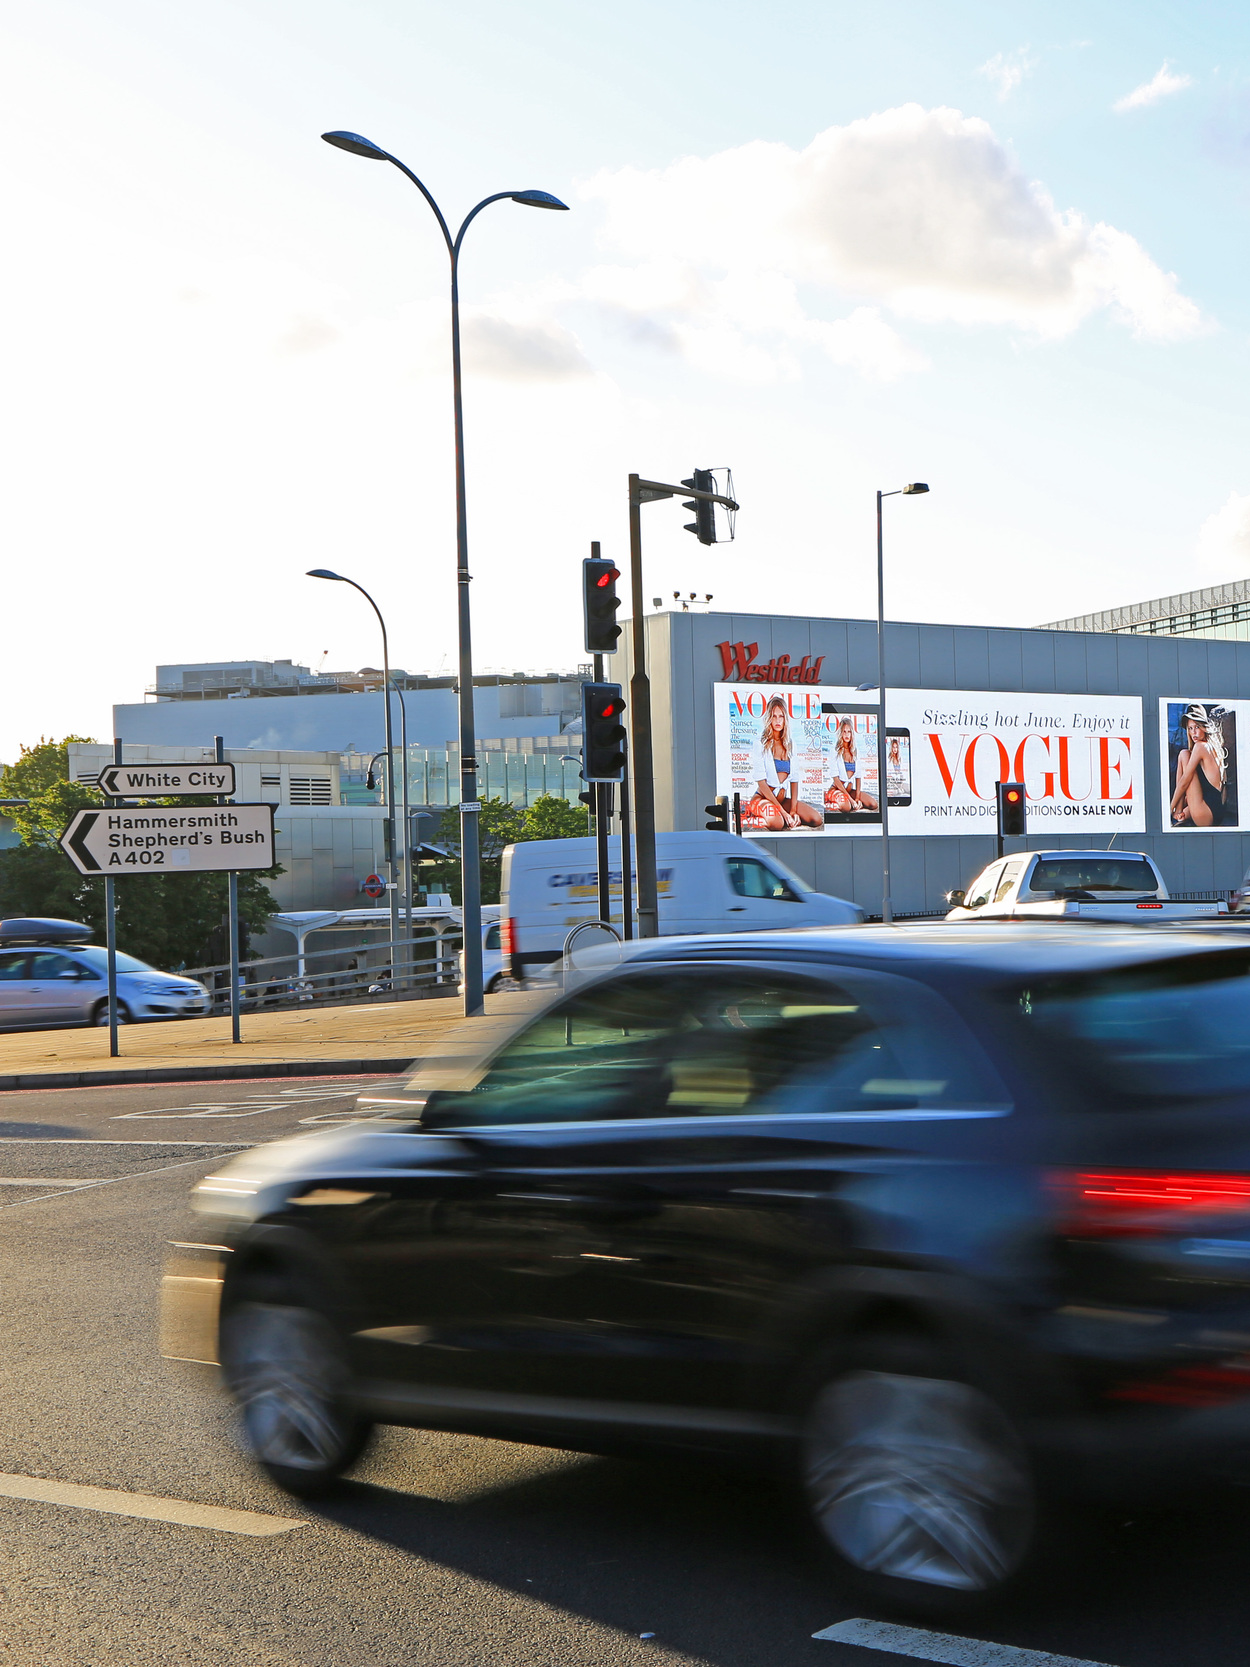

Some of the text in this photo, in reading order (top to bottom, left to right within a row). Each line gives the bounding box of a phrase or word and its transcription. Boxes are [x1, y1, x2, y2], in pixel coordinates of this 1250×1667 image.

[714, 640, 826, 684] Westfield
[731, 718, 753, 728] Sunset
[822, 714, 877, 734] OUE
[922, 709, 1130, 733] Sizzling hot June. Enjoy it
[923, 733, 1133, 801] VOGUE
[127, 771, 226, 789] White City
[739, 804, 781, 817] UMMER
[924, 805, 953, 817] PRINT
[955, 805, 977, 817] AND
[1025, 805, 1062, 816] DITIONS
[1063, 805, 1080, 816] ON
[1082, 805, 1106, 815] SALE
[1108, 805, 1133, 815] NOW
[108, 813, 238, 830] Hammersmith
[108, 829, 265, 849] Shepherd's Bush
[108, 850, 165, 866] A402
